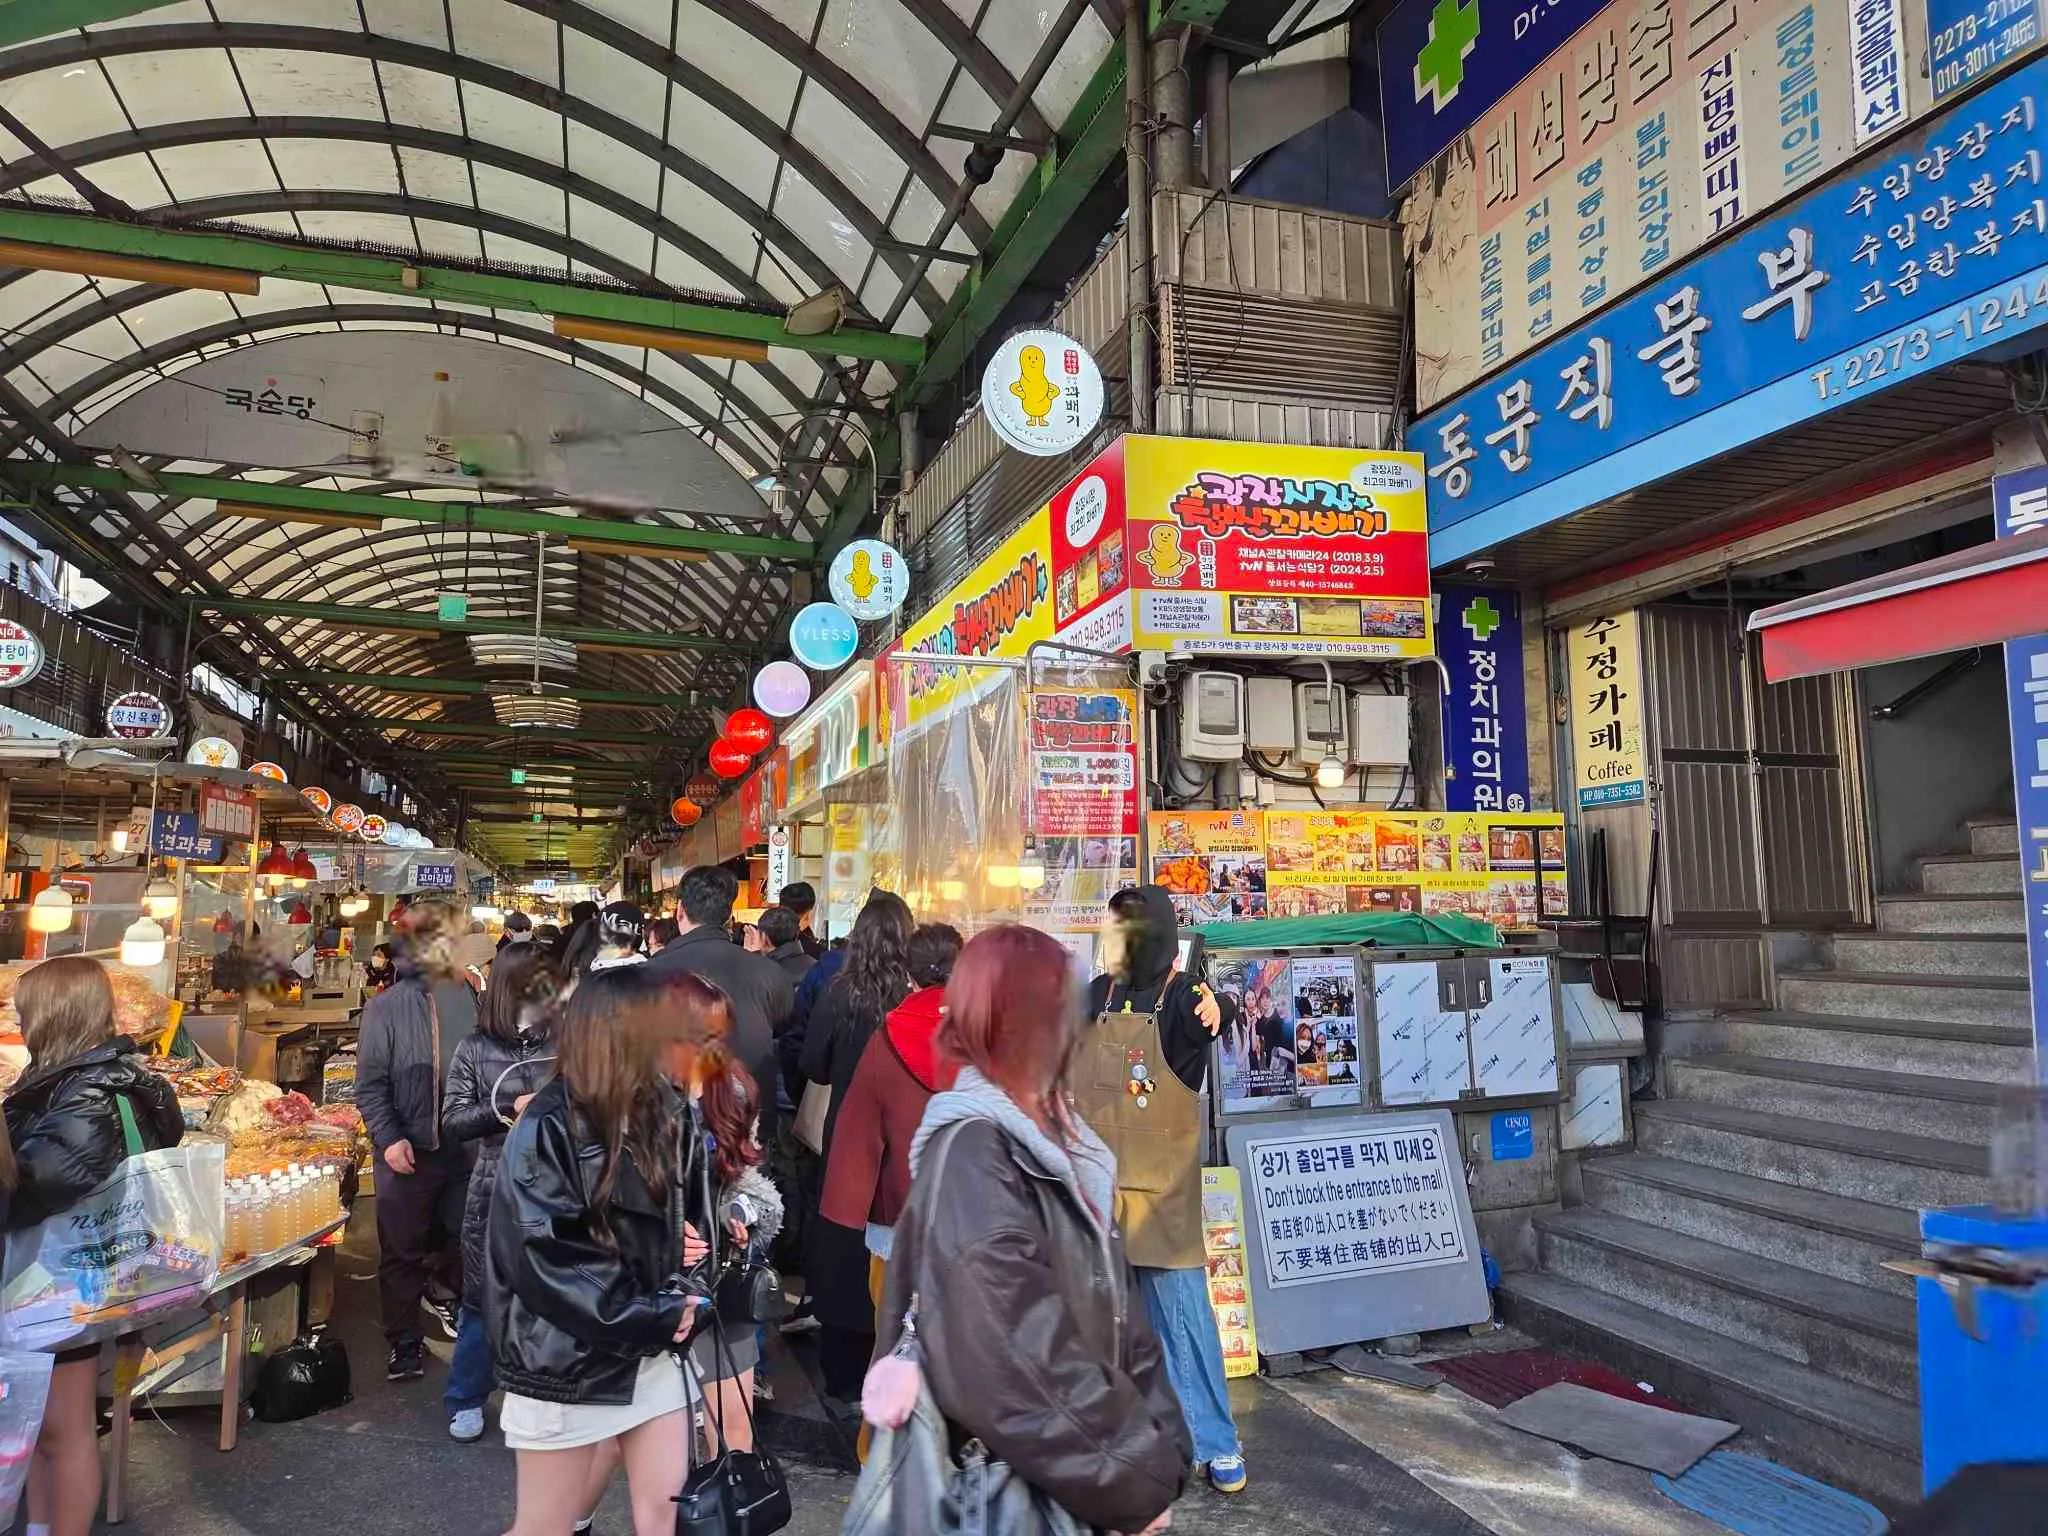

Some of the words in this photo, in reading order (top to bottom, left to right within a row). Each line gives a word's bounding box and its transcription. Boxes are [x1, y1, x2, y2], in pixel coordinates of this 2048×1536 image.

[1514, 0, 1561, 40] Dr.
[1934, 0, 2032, 60] 2273-21
[1846, 96, 2035, 217] 수입양장지
[1851, 150, 2041, 266] 수입양복지
[1854, 199, 2046, 314] 고급한복지
[226, 384, 317, 419] 국순당
[1200, 473, 1357, 511] 광장시장
[1326, 643, 1391, 654] 010.9498.3115
[1584, 615, 1628, 753] 수정카페
[1468, 650, 1503, 812] 정치과의원
[1588, 761, 1632, 780] Coffee
[1260, 1151, 1291, 1178] 상가
[1296, 1144, 1354, 1173] 출입구를
[1360, 1140, 1389, 1167] 막지
[1394, 1136, 1437, 1164] 마세요
[1264, 1182, 1296, 1209] Don't
[1296, 1179, 1325, 1206] block
[1326, 1177, 1344, 1202] the
[1345, 1174, 1390, 1200] entrance
[1390, 1174, 1402, 1193] to
[1402, 1170, 1420, 1193] the
[1421, 1167, 1444, 1190] mall
